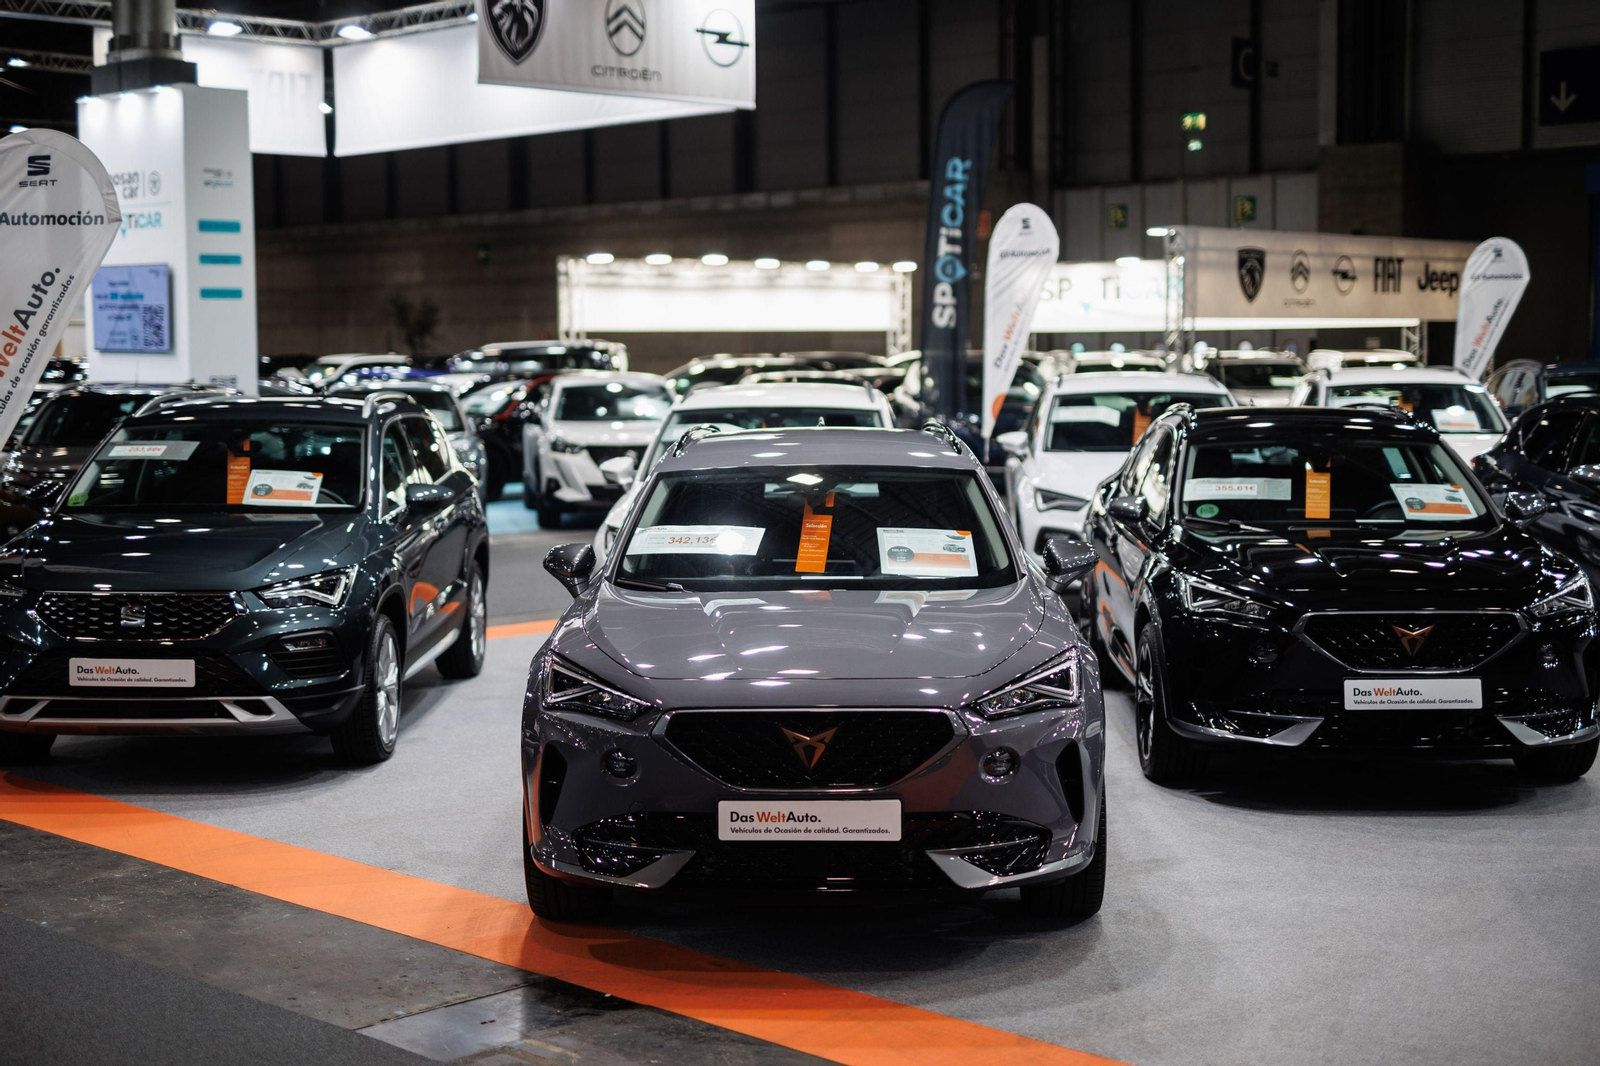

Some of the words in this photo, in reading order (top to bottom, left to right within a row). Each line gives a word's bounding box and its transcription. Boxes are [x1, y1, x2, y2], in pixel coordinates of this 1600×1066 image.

[18, 179, 58, 188] SEAT
[0, 211, 105, 226] Automoción
[1374, 256, 1404, 293] FIAT
[1417, 261, 1459, 298] Jeep
[10, 375, 21, 389] de
[18, 337, 42, 375] ocasión
[39, 274, 75, 337] garantizados
[77, 665, 94, 675] Das
[95, 665, 140, 675] WeltAuto.
[1353, 688, 1372, 697] Das
[1373, 687, 1423, 697] WeltAuto.
[730, 811, 755, 823] Das
[756, 811, 822, 823] WeltAuto.
[730, 826, 762, 834] Vehículos
